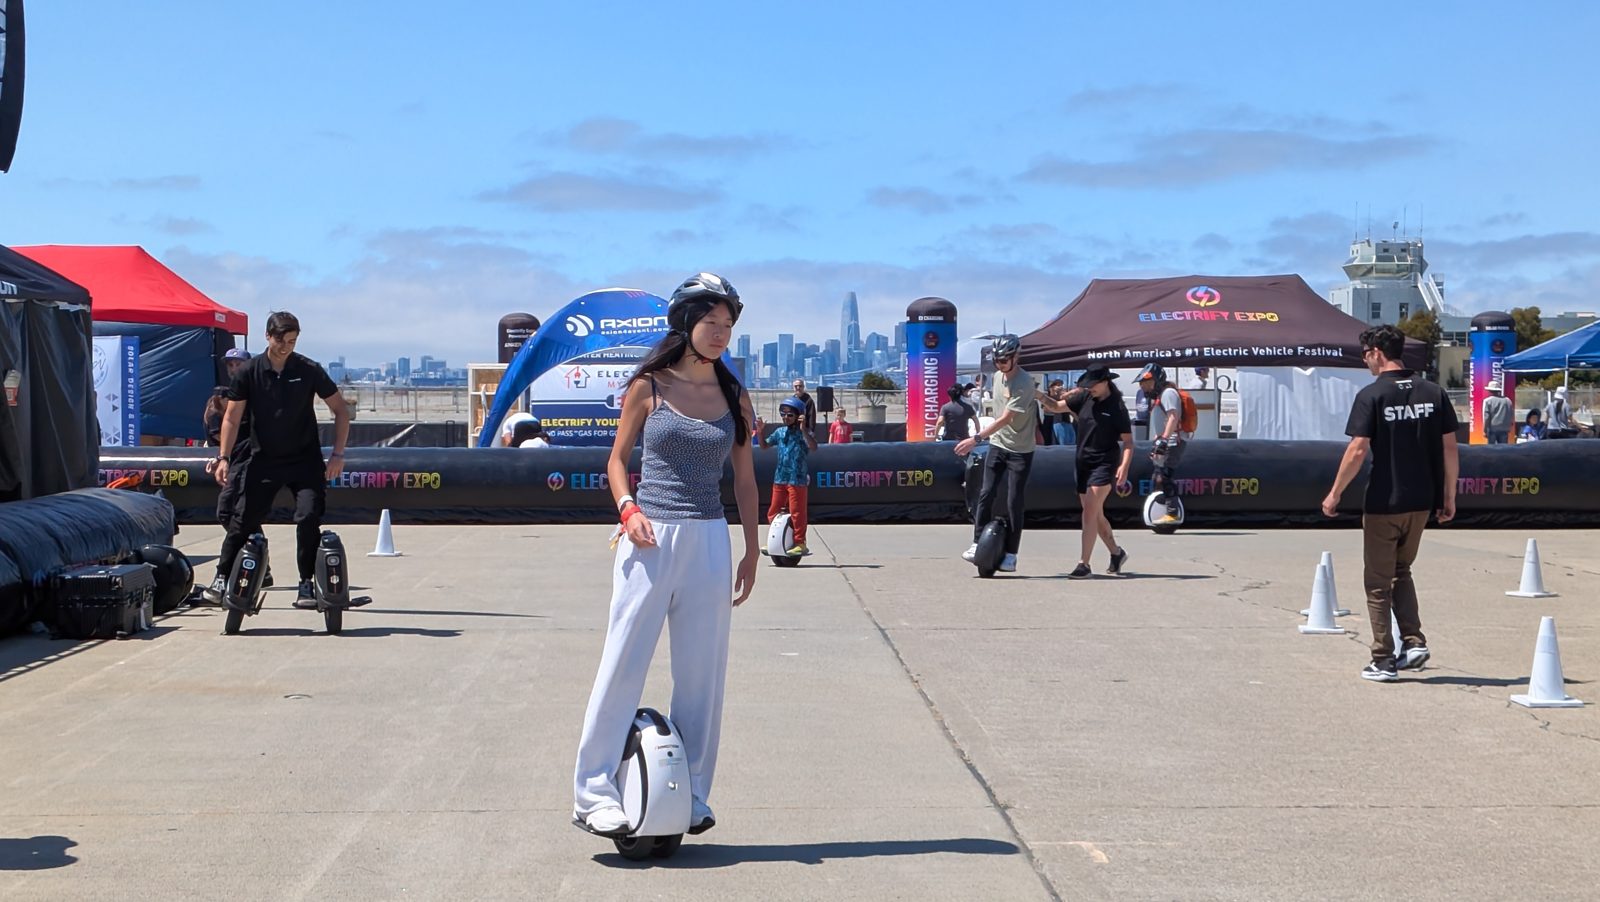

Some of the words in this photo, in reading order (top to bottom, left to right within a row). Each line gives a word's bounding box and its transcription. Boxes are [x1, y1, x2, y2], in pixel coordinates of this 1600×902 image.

[600, 316, 668, 329] AXION
[1139, 310, 1230, 322] ELECTRIFY
[1234, 311, 1280, 322] EXPO
[1087, 350, 1120, 359] North
[1124, 348, 1181, 358] America's
[1184, 347, 1199, 357] #1
[1203, 347, 1249, 356] Electric
[1252, 346, 1294, 356] Vehicle
[1297, 346, 1343, 357] Festival
[924, 357, 939, 420] CHARGING
[1383, 402, 1434, 421] STAFF
[541, 418, 593, 427] ELECTRIFY
[150, 469, 189, 487] EXPO
[326, 471, 400, 489] LECTRIFY
[403, 471, 441, 489] EXPO
[816, 471, 894, 488] ELECTRIFY
[896, 469, 934, 487] EXPO
[1221, 477, 1260, 495] EXPO
[1502, 476, 1540, 495] EXPO
